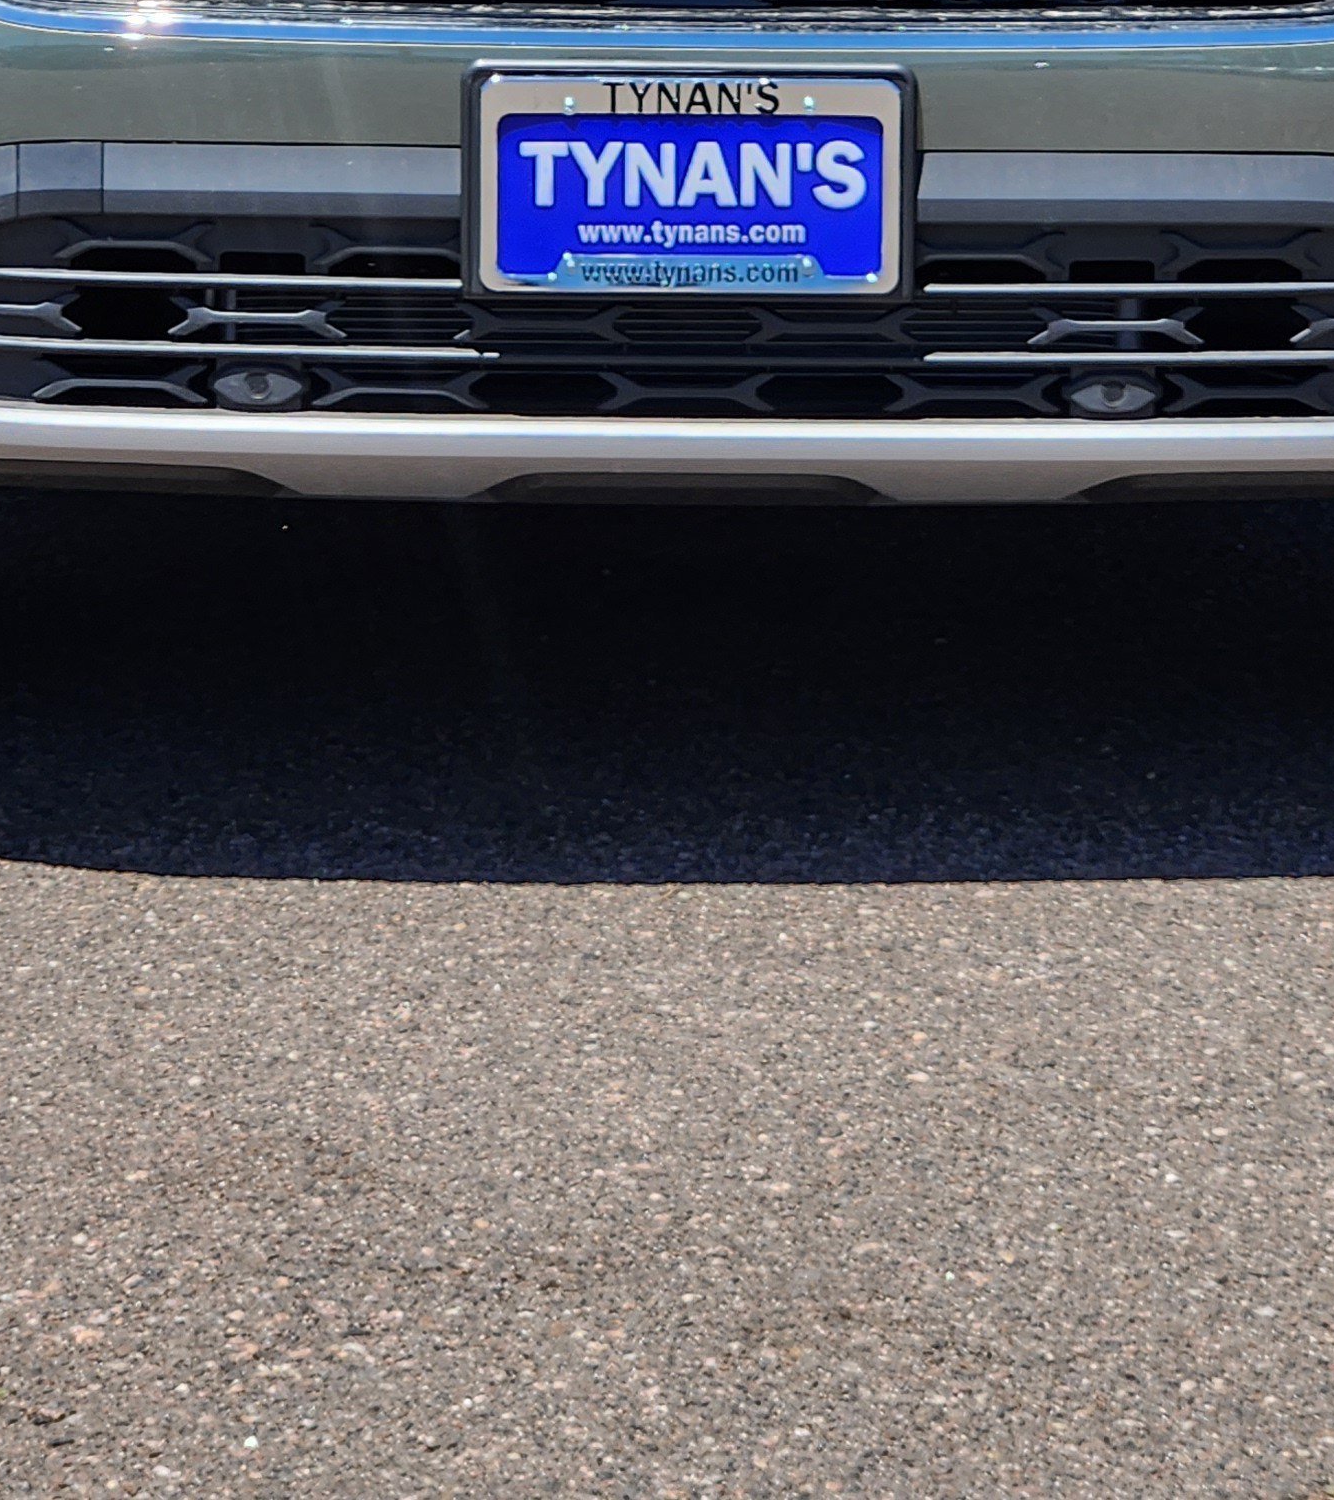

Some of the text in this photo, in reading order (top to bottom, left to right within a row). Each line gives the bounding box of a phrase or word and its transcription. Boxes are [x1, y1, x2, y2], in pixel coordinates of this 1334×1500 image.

[601, 81, 780, 116] TYNAN'S
[518, 139, 868, 209] TYNAN'S
[577, 220, 807, 249] www.tynans.com
